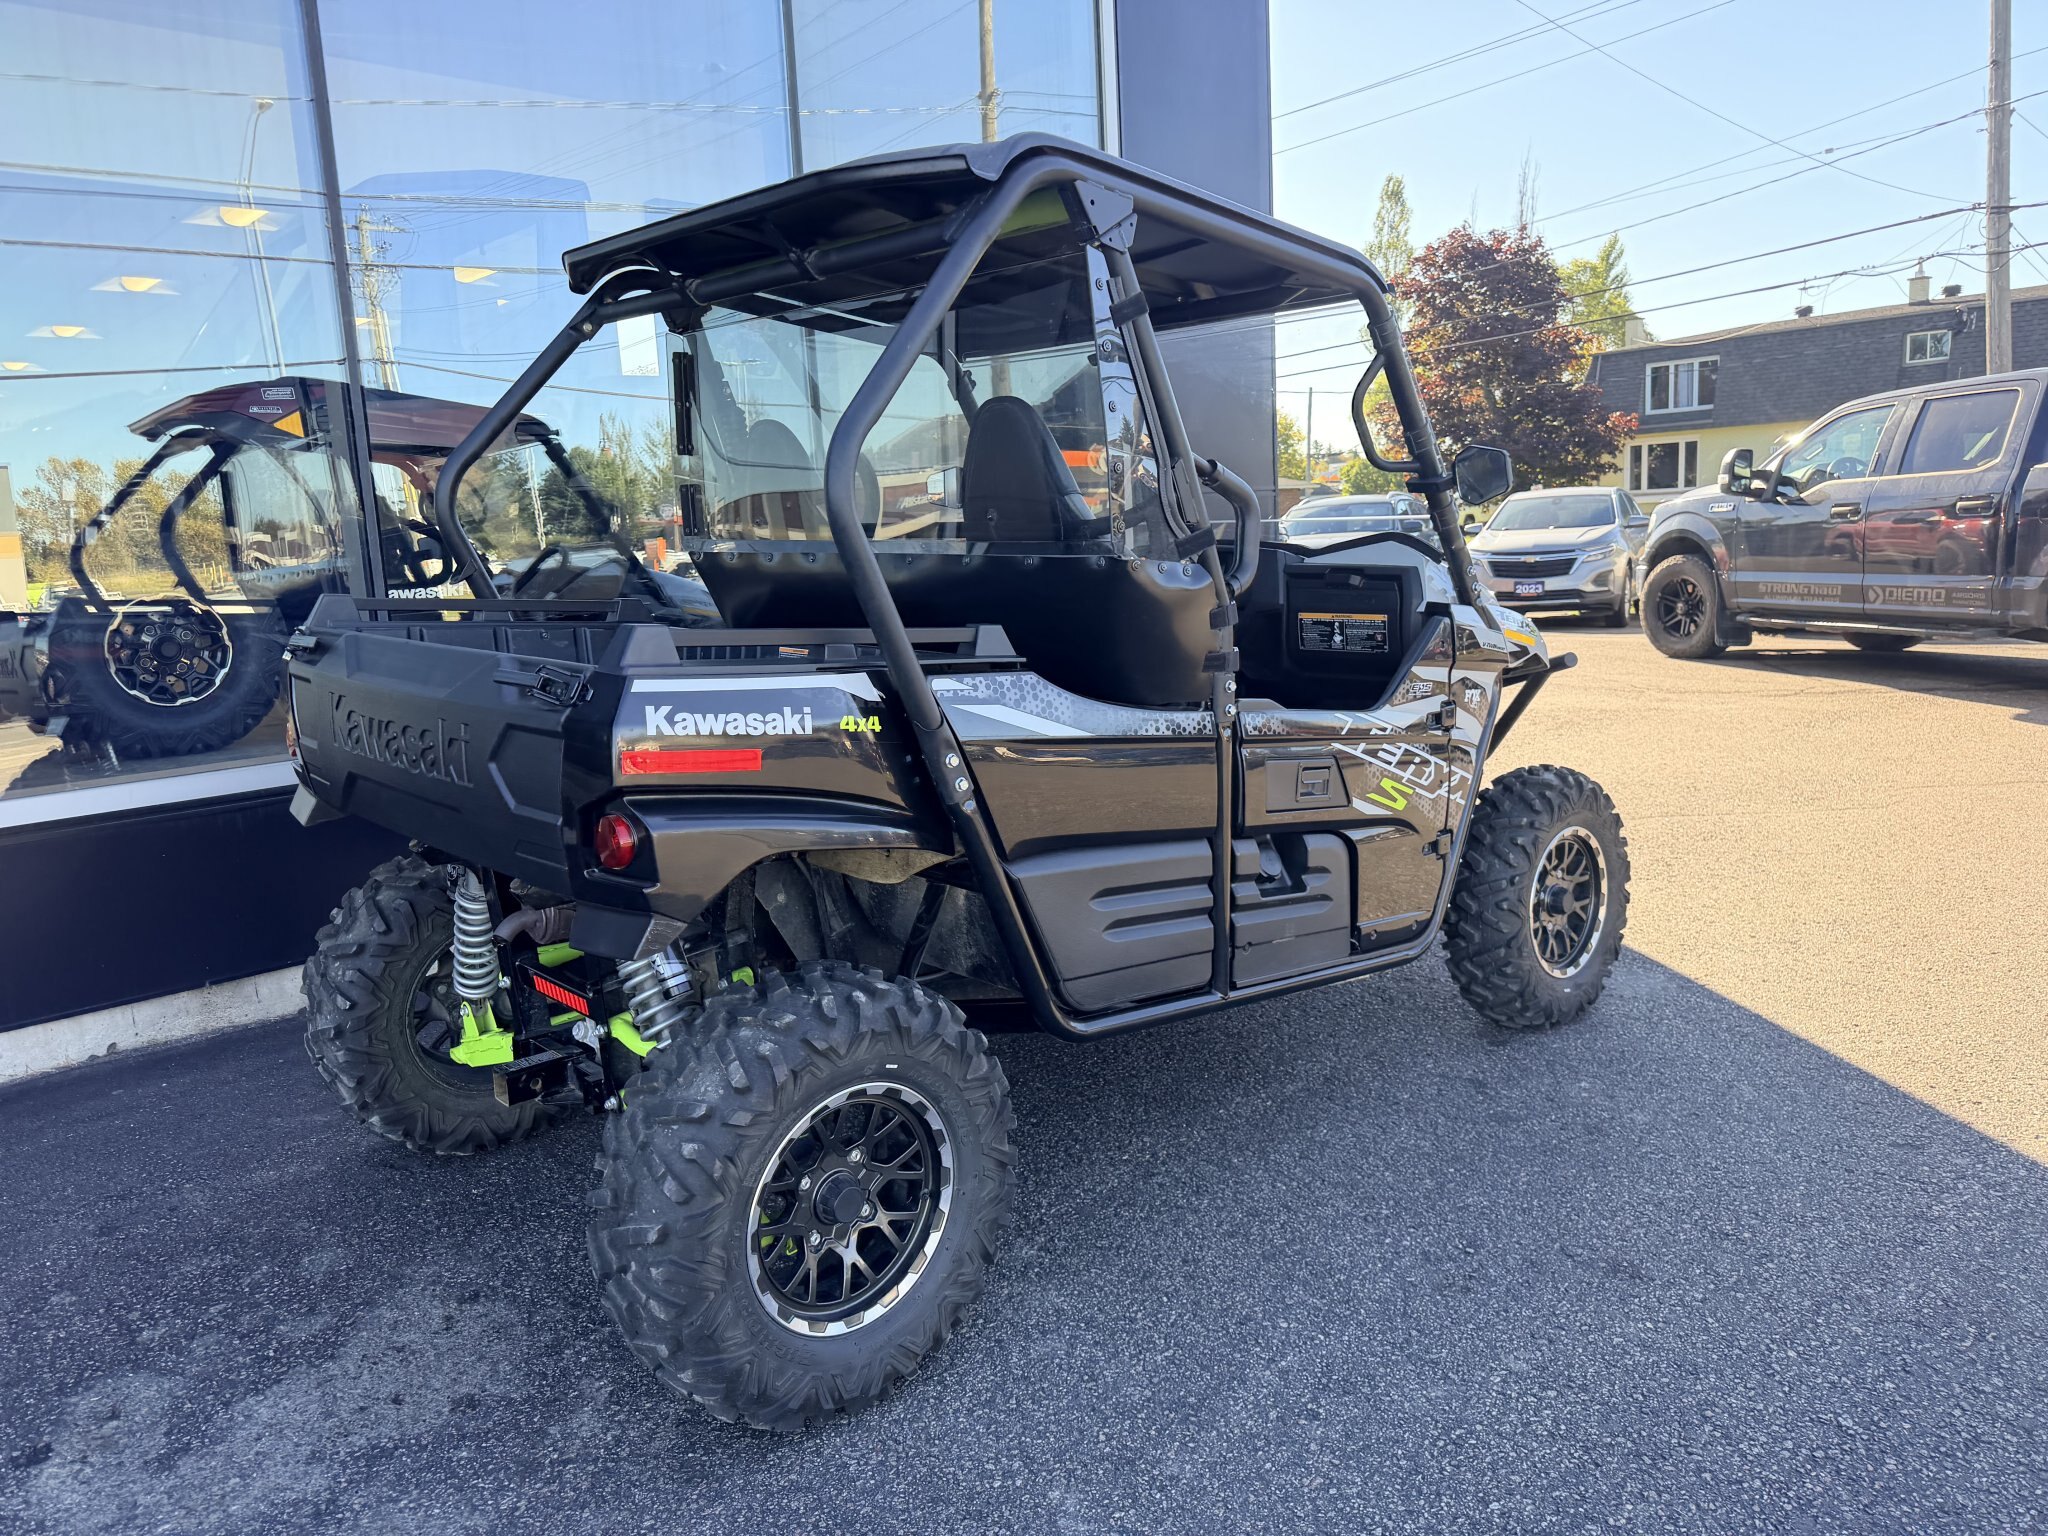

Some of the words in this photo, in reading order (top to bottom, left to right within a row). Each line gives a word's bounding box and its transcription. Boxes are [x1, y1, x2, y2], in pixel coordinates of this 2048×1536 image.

[388, 584, 464, 599] awasaki
[1515, 584, 1543, 594] 2023
[645, 705, 813, 736] Kawasaki
[839, 715, 882, 733] 4x4
[328, 691, 475, 788] Kawasaki
